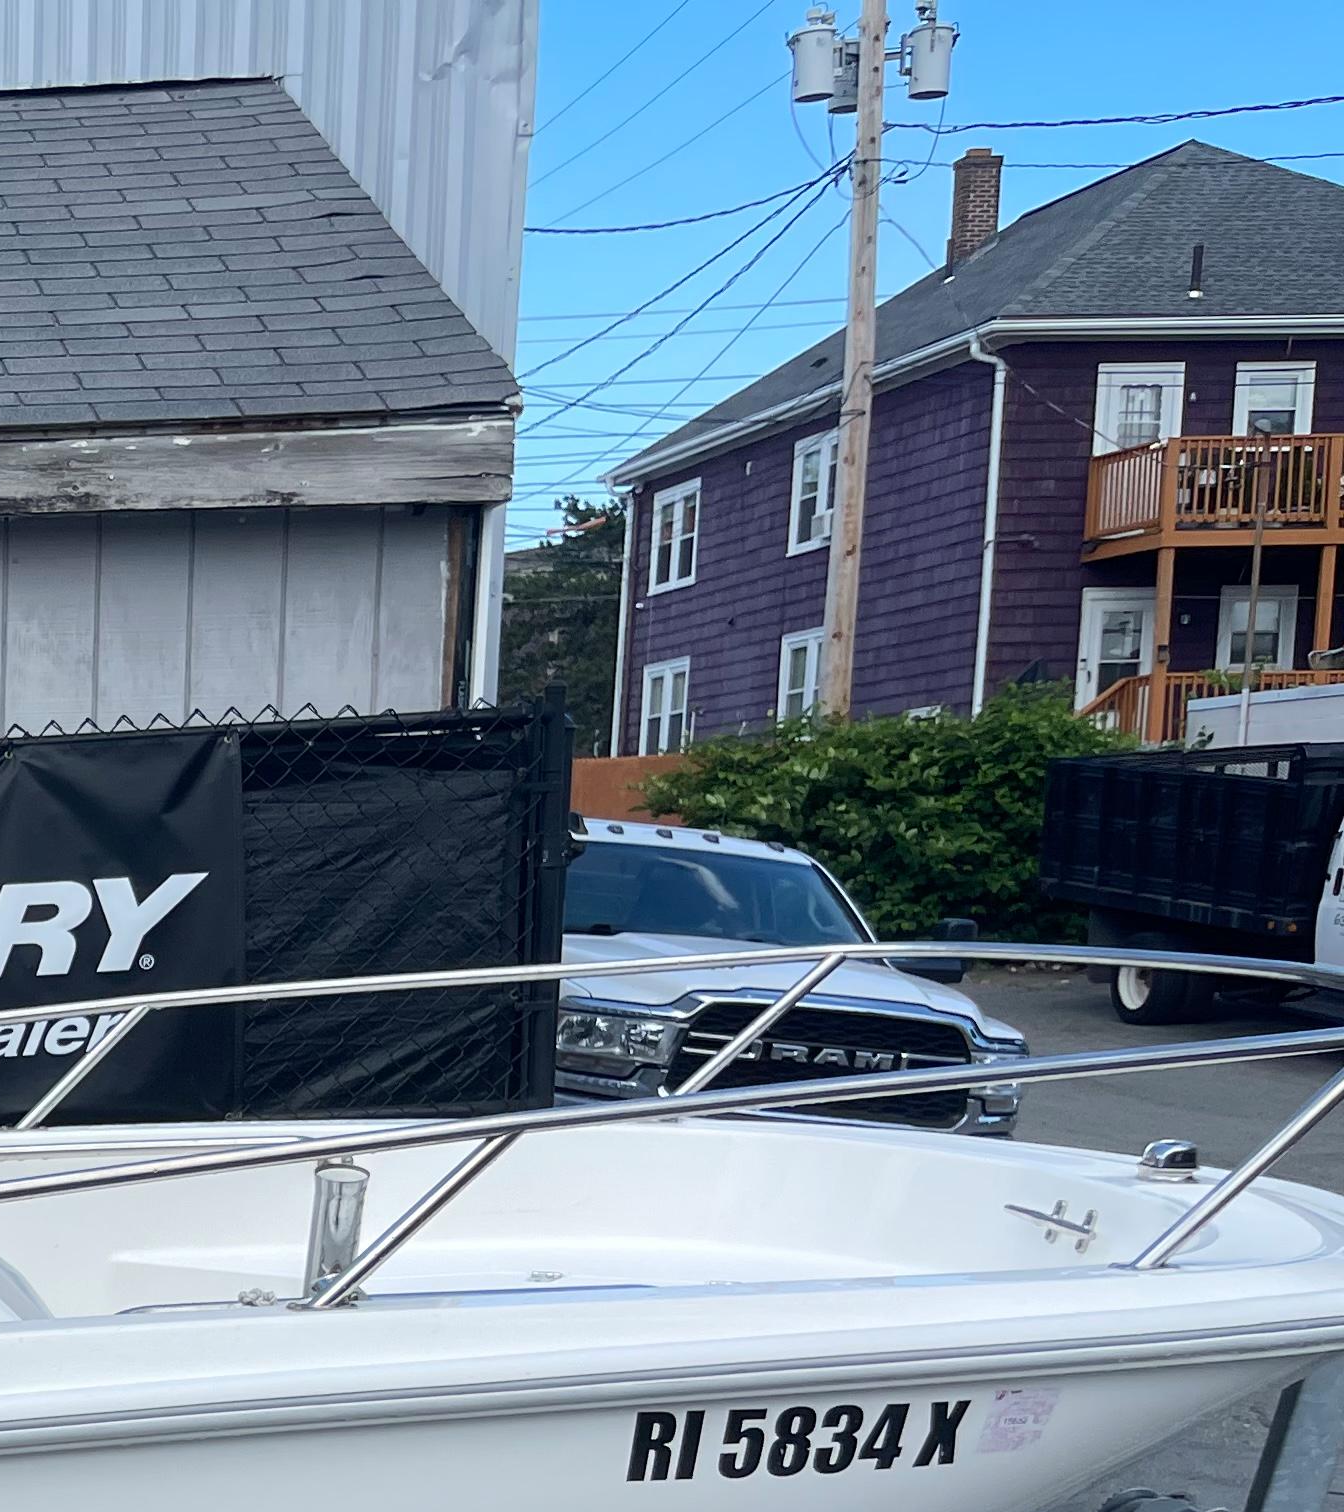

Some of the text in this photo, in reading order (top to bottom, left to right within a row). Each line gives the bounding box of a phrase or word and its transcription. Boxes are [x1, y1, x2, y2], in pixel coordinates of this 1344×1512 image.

[770, 1043, 894, 1070] RAM
[626, 1409, 706, 1482] RI
[717, 1403, 911, 1479] 5834
[912, 1400, 972, 1468] X
